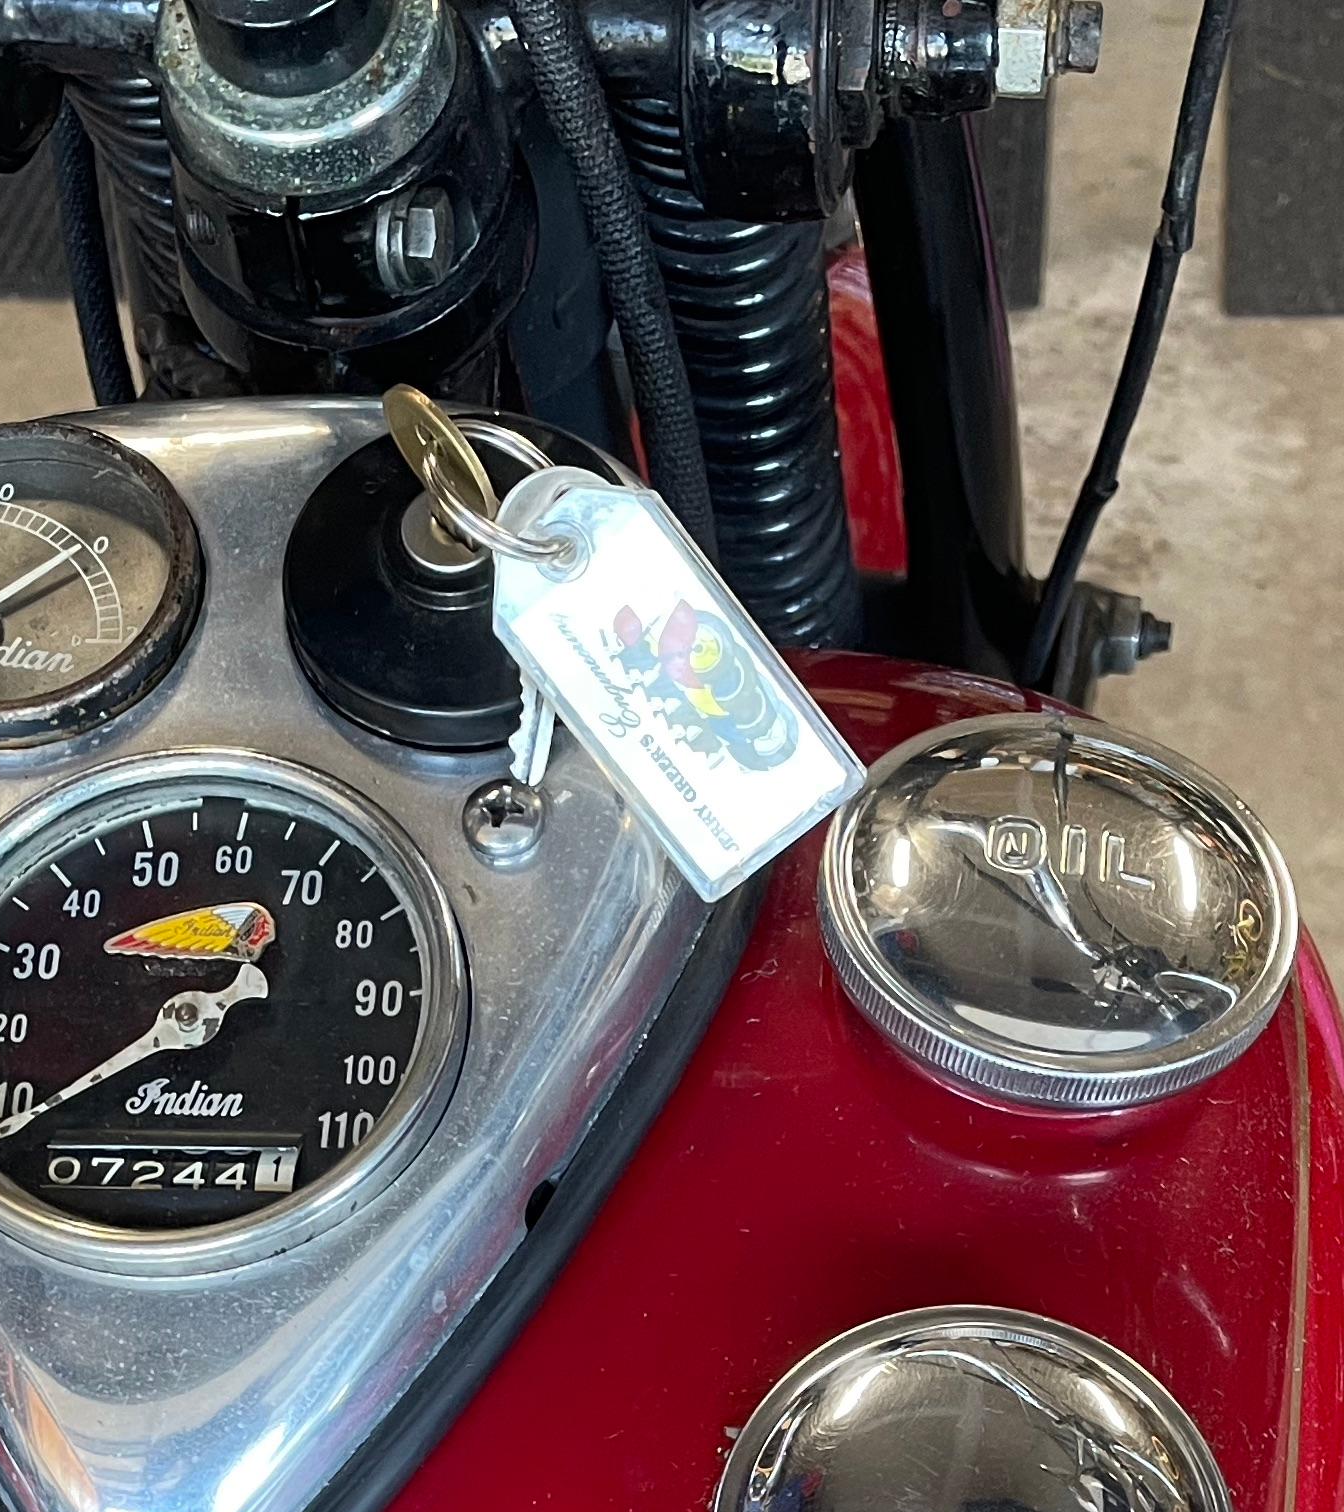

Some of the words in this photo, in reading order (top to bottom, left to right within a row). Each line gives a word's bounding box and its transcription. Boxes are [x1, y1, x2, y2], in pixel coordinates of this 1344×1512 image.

[93, 536, 109, 554] 0
[694, 804, 740, 852] JERRY
[132, 850, 180, 887] 50
[214, 845, 253, 874] 60
[984, 815, 1155, 891] OIL
[63, 889, 102, 919] 40
[281, 870, 324, 906] 70
[336, 920, 374, 950] 80
[12, 942, 61, 980] 30
[355, 980, 404, 1018] 90
[343, 1054, 396, 1086] 100
[125, 1077, 244, 1119] Indian
[318, 1112, 375, 1150] 110
